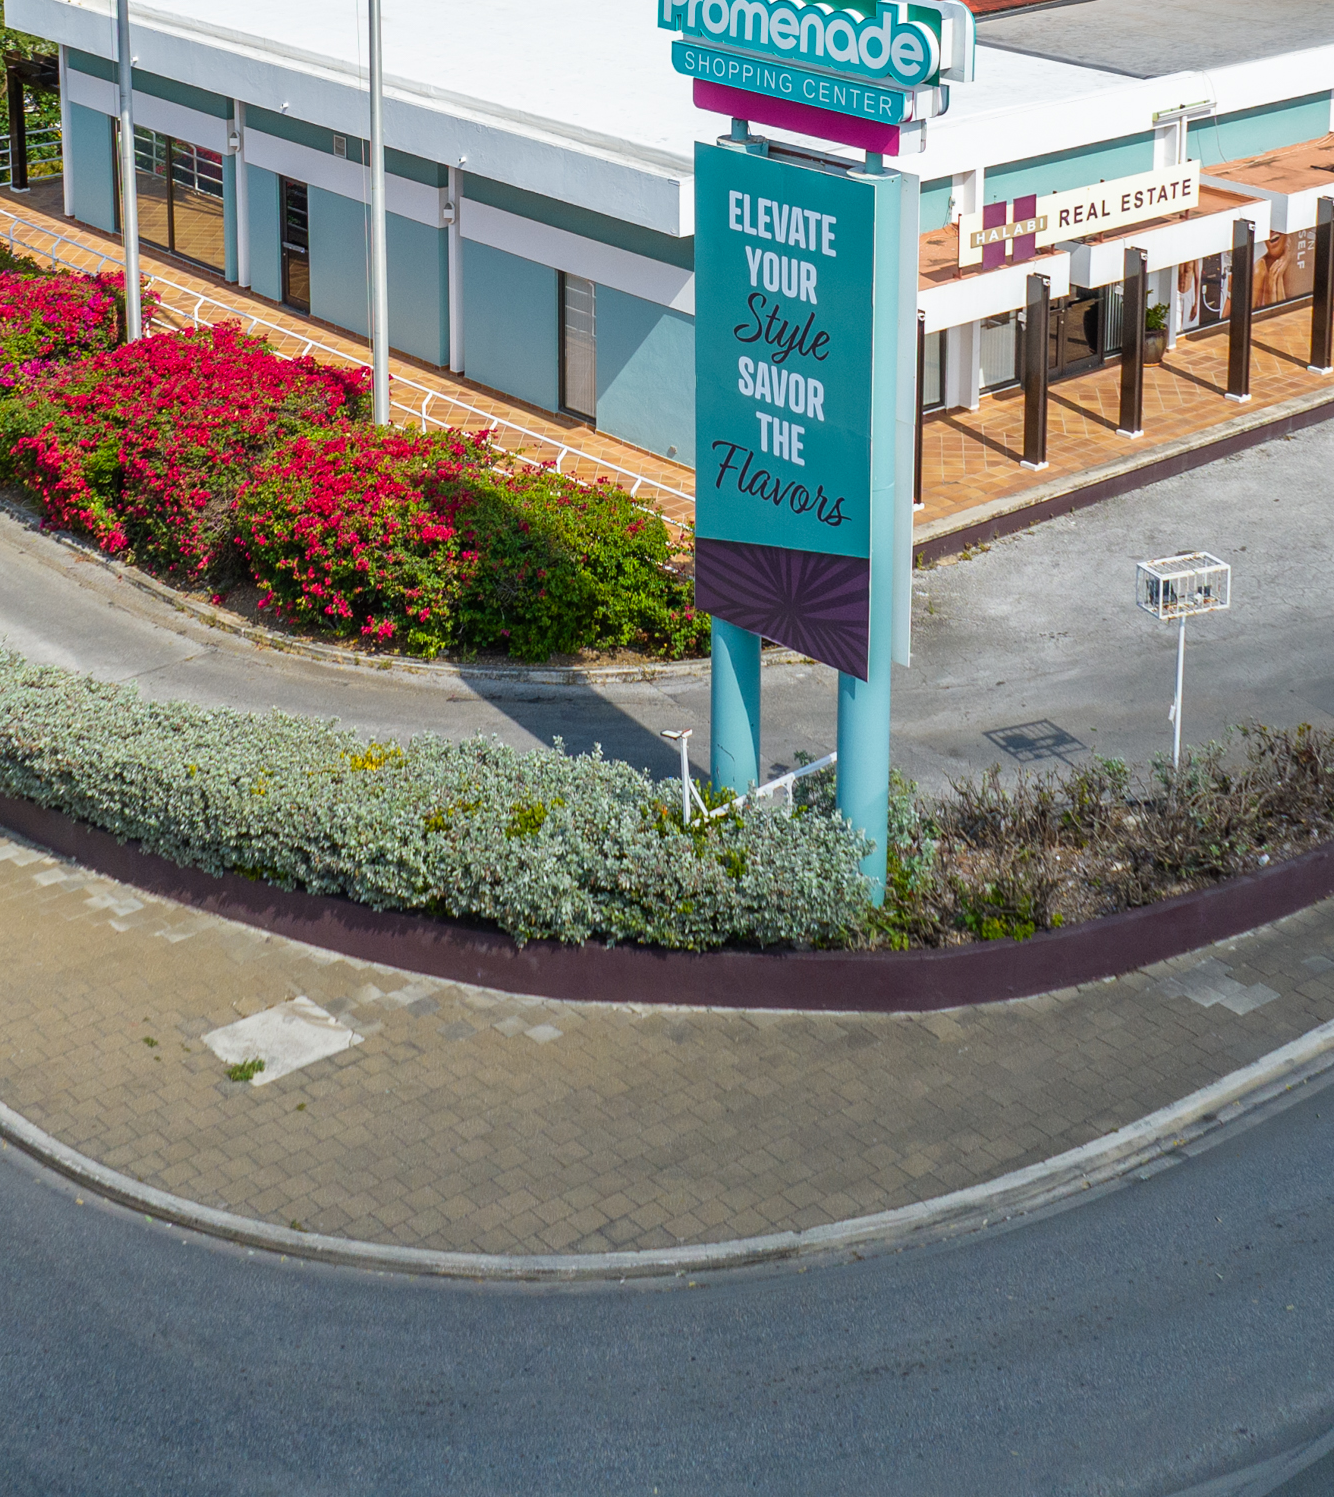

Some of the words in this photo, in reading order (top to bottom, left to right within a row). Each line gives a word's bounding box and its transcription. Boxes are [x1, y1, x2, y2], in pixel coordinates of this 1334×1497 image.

[684, 51, 793, 94] SHOPPING
[802, 78, 893, 117] CENTER
[728, 189, 837, 258] ELEVATE
[975, 217, 1045, 245] HALABI
[1059, 199, 1111, 228] REAL
[1121, 178, 1192, 212] ESTATE
[744, 245, 818, 305] YOUR
[733, 292, 831, 364] Style
[738, 355, 825, 422] SAVOR
[755, 410, 805, 467] THE
[711, 440, 853, 527] Flavors
